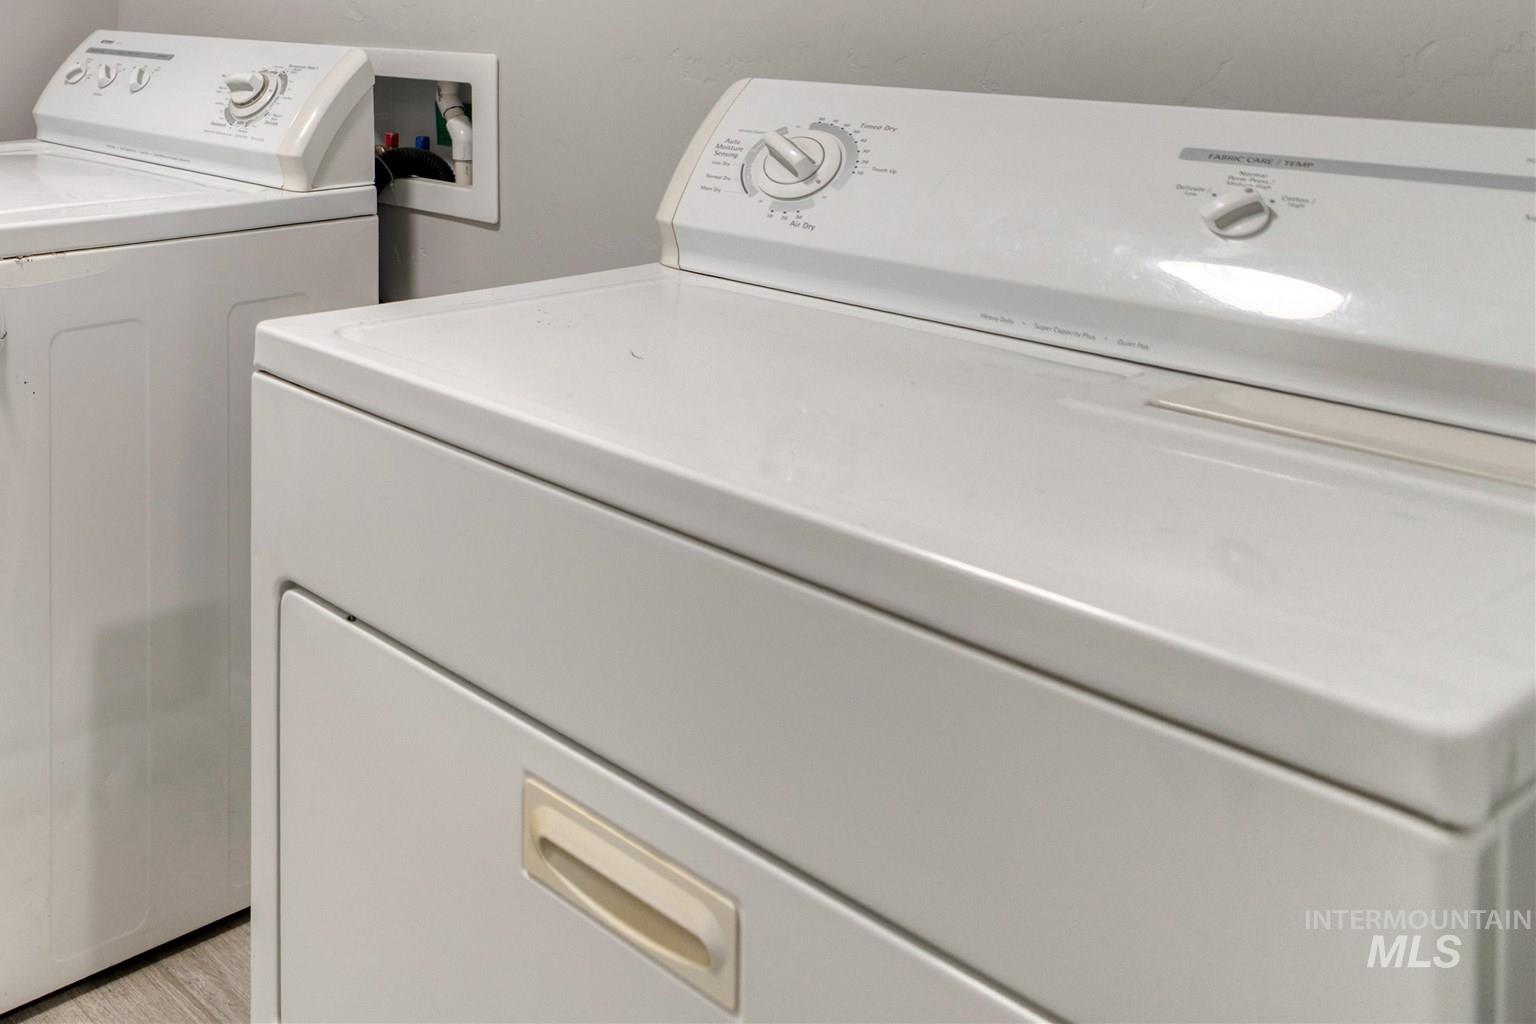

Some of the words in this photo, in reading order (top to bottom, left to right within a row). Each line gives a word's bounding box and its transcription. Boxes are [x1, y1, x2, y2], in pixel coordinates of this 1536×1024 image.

[883, 124, 898, 132] Dry
[724, 137, 742, 145] Auto
[714, 143, 745, 153] Moisture
[713, 150, 739, 159] Sensing
[1208, 153, 1245, 163] FABRIC
[1246, 156, 1274, 166] CARE
[1284, 160, 1315, 169] TEMP
[789, 219, 801, 229] Air
[802, 222, 816, 232] Dry
